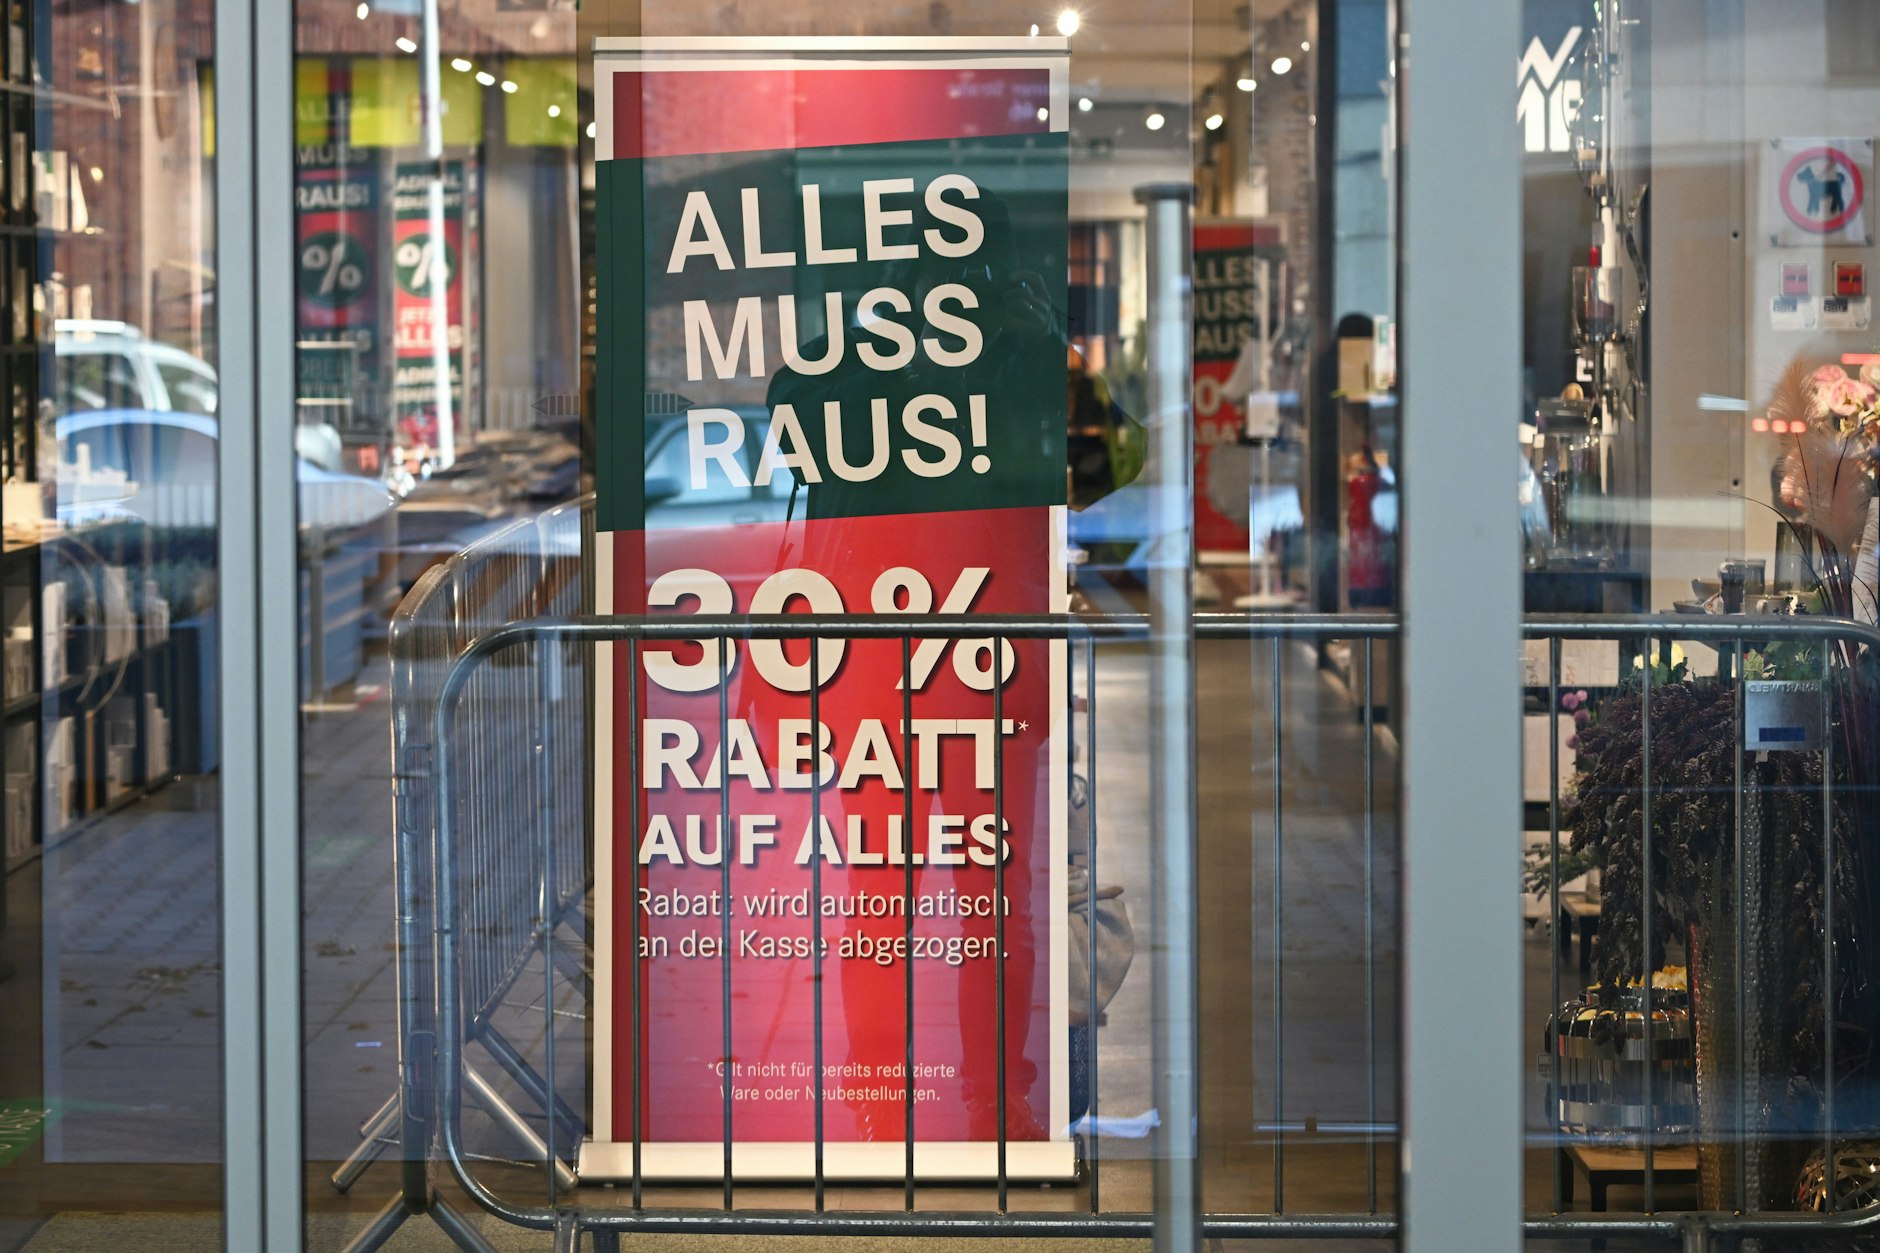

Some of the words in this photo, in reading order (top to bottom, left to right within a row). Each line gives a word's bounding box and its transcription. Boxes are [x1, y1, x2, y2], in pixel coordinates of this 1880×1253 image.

[295, 184, 370, 208] RAUS!
[666, 174, 985, 273] ALLES
[302, 243, 362, 295] %
[397, 242, 449, 290] %
[1193, 256, 1261, 287] LLES
[1194, 288, 1261, 320] USS
[683, 283, 984, 381] MUSS
[687, 393, 992, 490] RAUS!
[639, 814, 776, 866] AUF
[794, 814, 1010, 865] ALLES
[743, 887, 808, 916] wird
[820, 887, 1010, 916] automatisch
[740, 929, 828, 957] Kasse
[838, 929, 1009, 965] abgezogen.
[747, 1061, 786, 1077] nicht
[791, 1061, 812, 1077] für
[765, 1084, 800, 1100] oder
